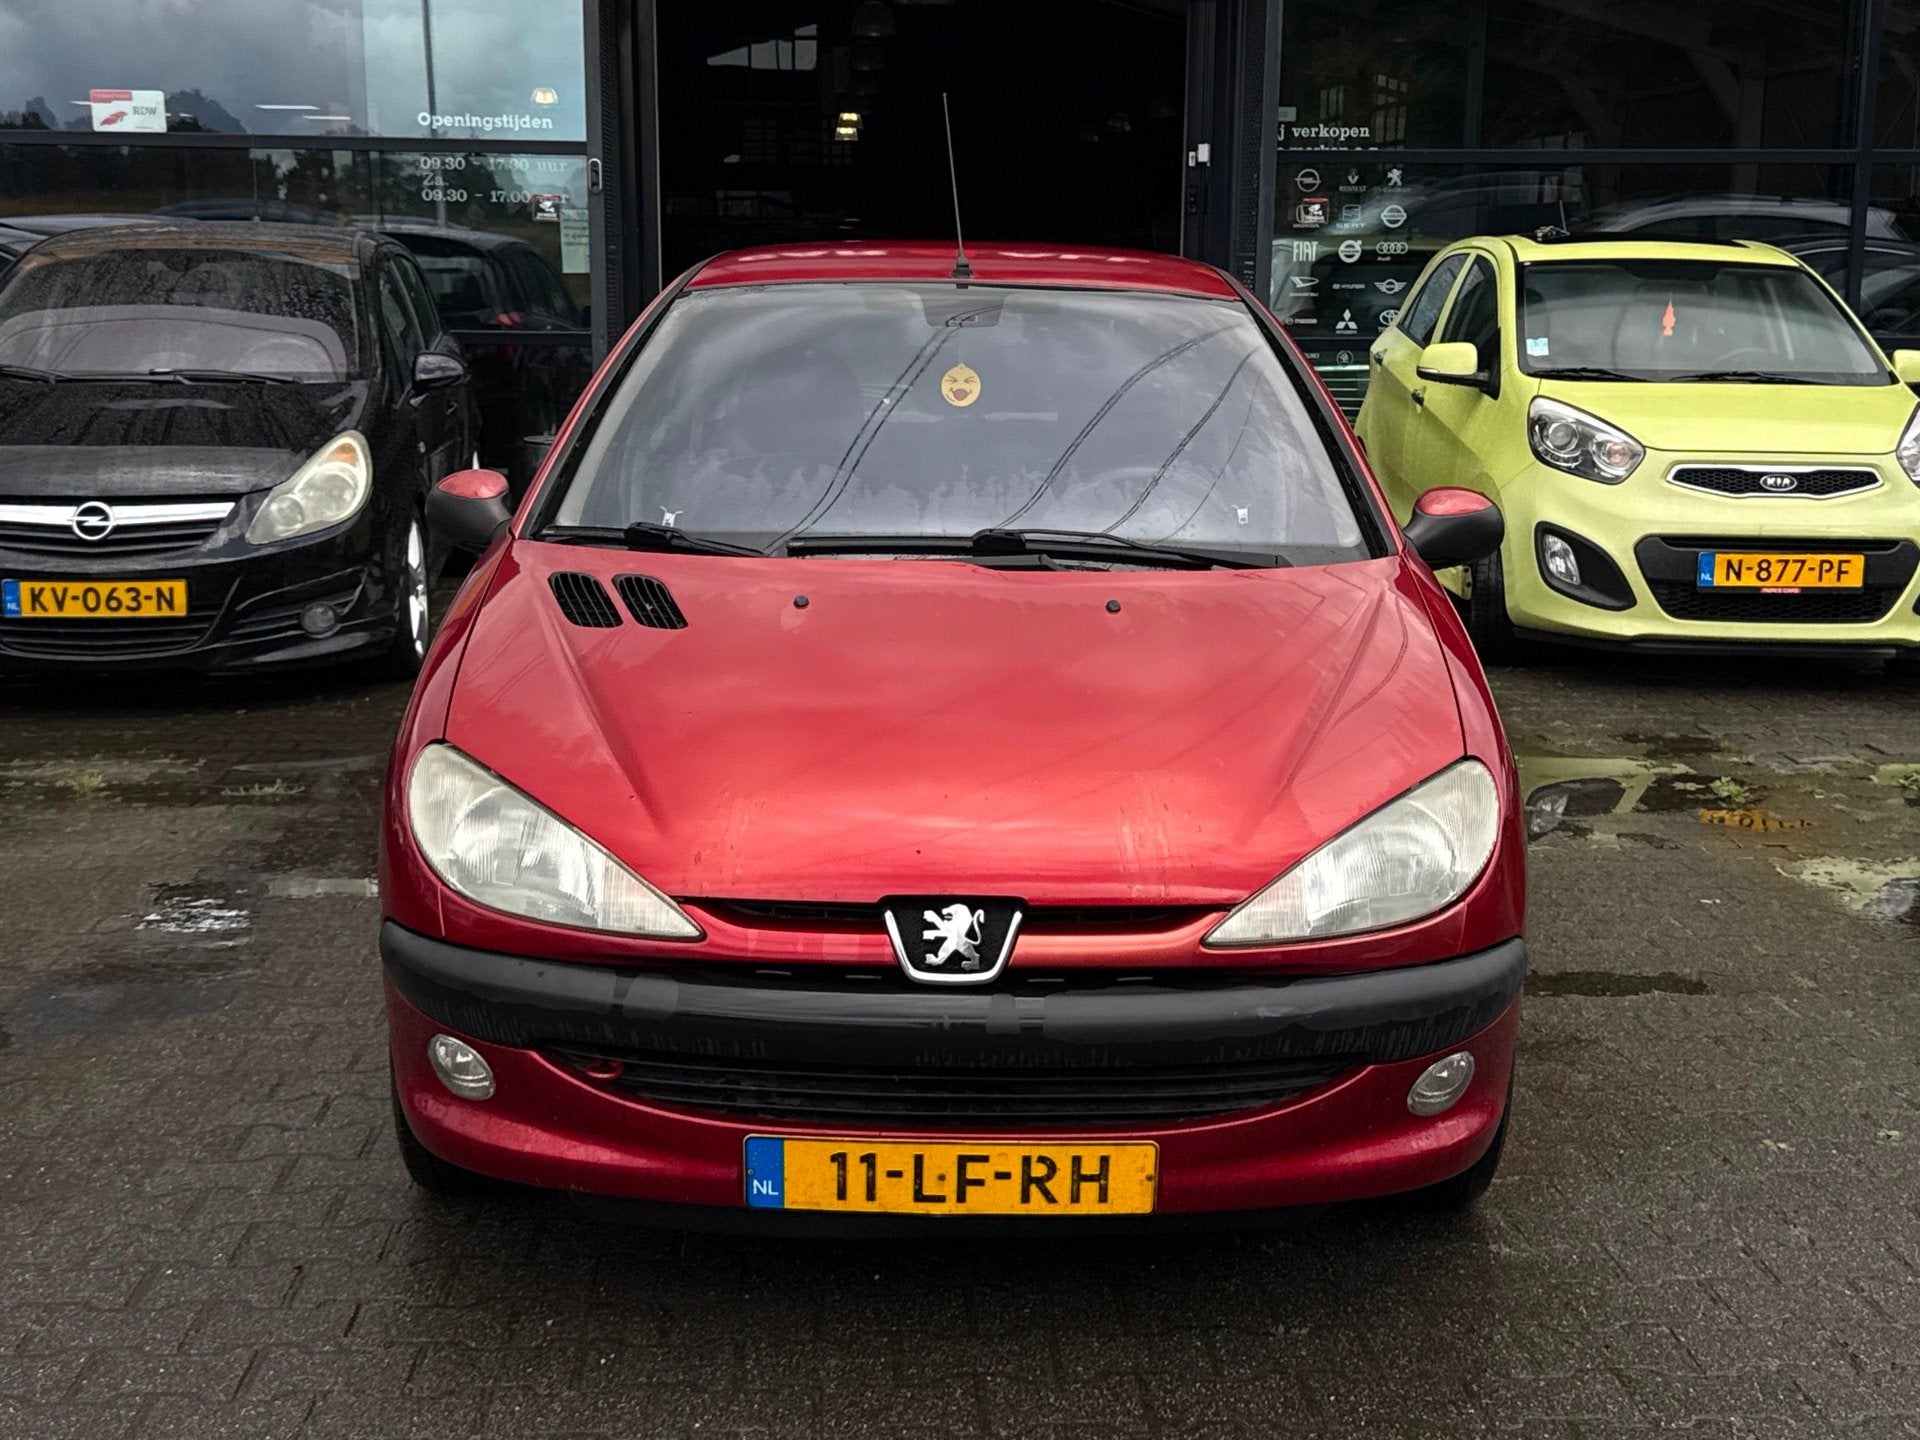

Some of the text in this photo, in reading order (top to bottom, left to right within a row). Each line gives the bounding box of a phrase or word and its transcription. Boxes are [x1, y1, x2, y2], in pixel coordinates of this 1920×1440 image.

[417, 112, 553, 132] Openingstijden
[1291, 123, 1370, 142] verkopen
[420, 157, 466, 171] 09.30
[488, 158, 529, 172] 17.30
[537, 161, 567, 172] uur
[421, 189, 467, 202] 09.30
[490, 190, 530, 203] 17.00
[1293, 241, 1319, 262] FIAT
[1766, 477, 1791, 487] KIA
[1701, 573, 1712, 581] NL
[1725, 558, 1852, 583] N-877-PF
[7, 602, 20, 611] NL
[29, 586, 175, 613] KV-063-N
[829, 1150, 1111, 1204] 11-LF-RH
[752, 1179, 779, 1196] NL
